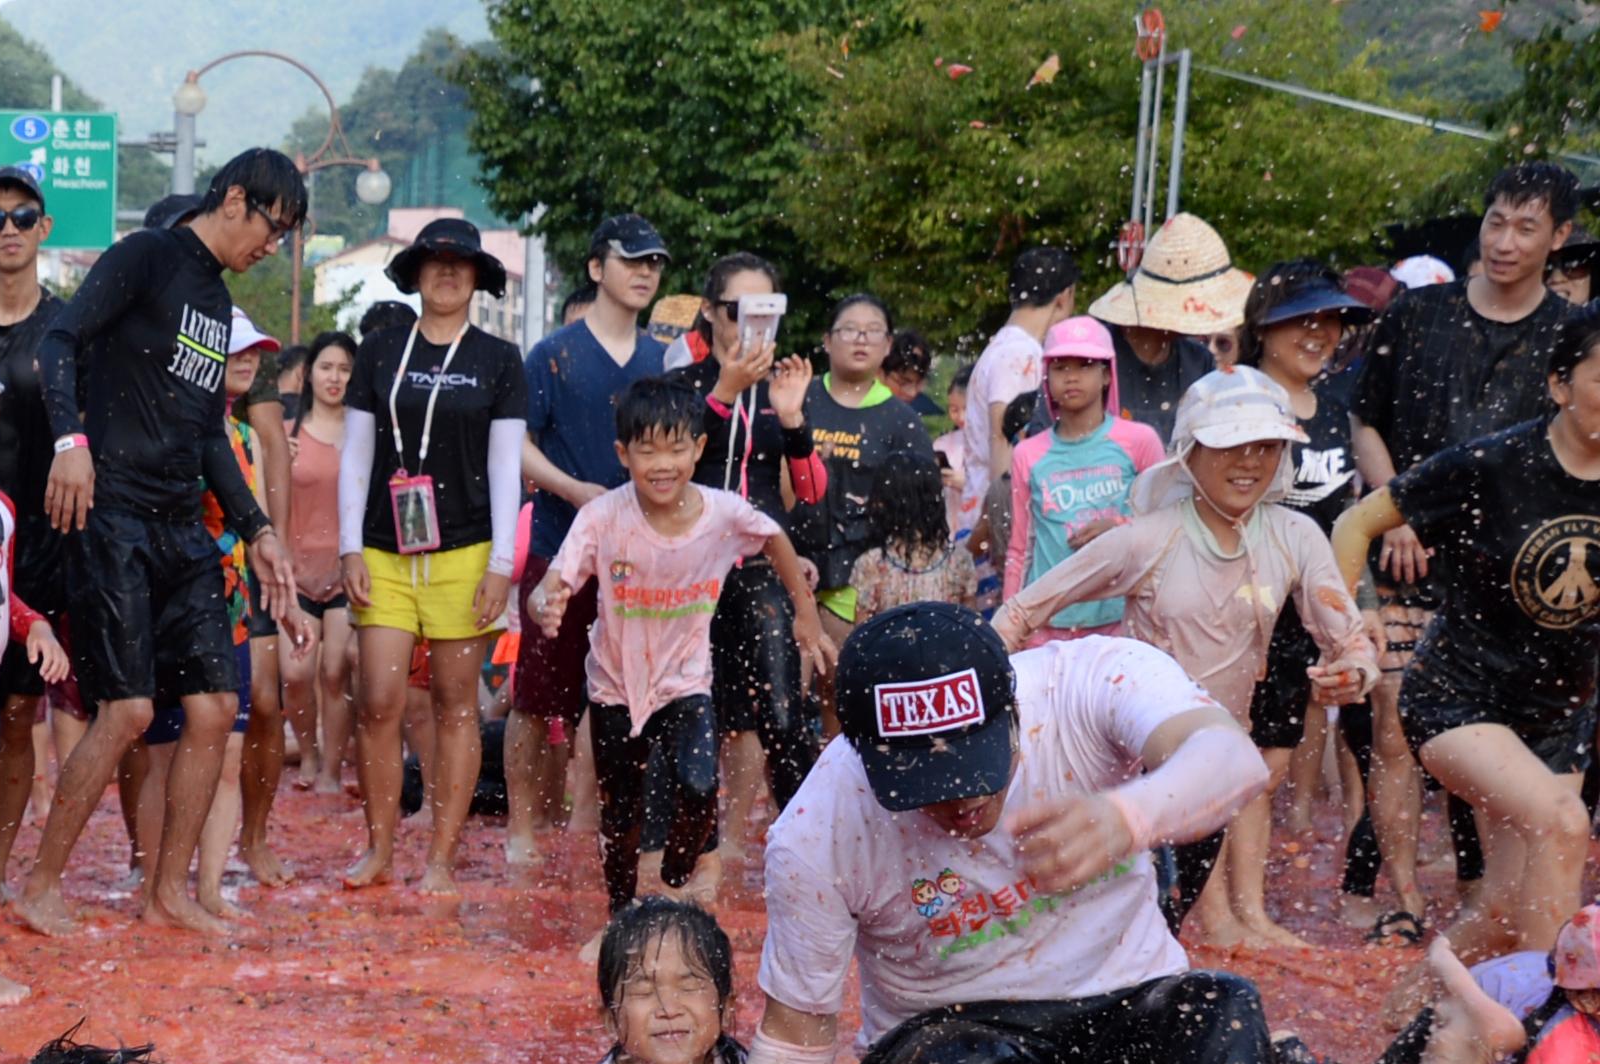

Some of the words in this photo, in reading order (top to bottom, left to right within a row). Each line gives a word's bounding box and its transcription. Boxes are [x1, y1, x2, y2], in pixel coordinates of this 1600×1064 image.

[23, 119, 37, 138] 5
[52, 156, 91, 177] 화천
[812, 428, 861, 446] Hello!
[1050, 479, 1131, 511] Dream
[1563, 520, 1589, 533] FLY
[882, 681, 976, 728] TEXAS
